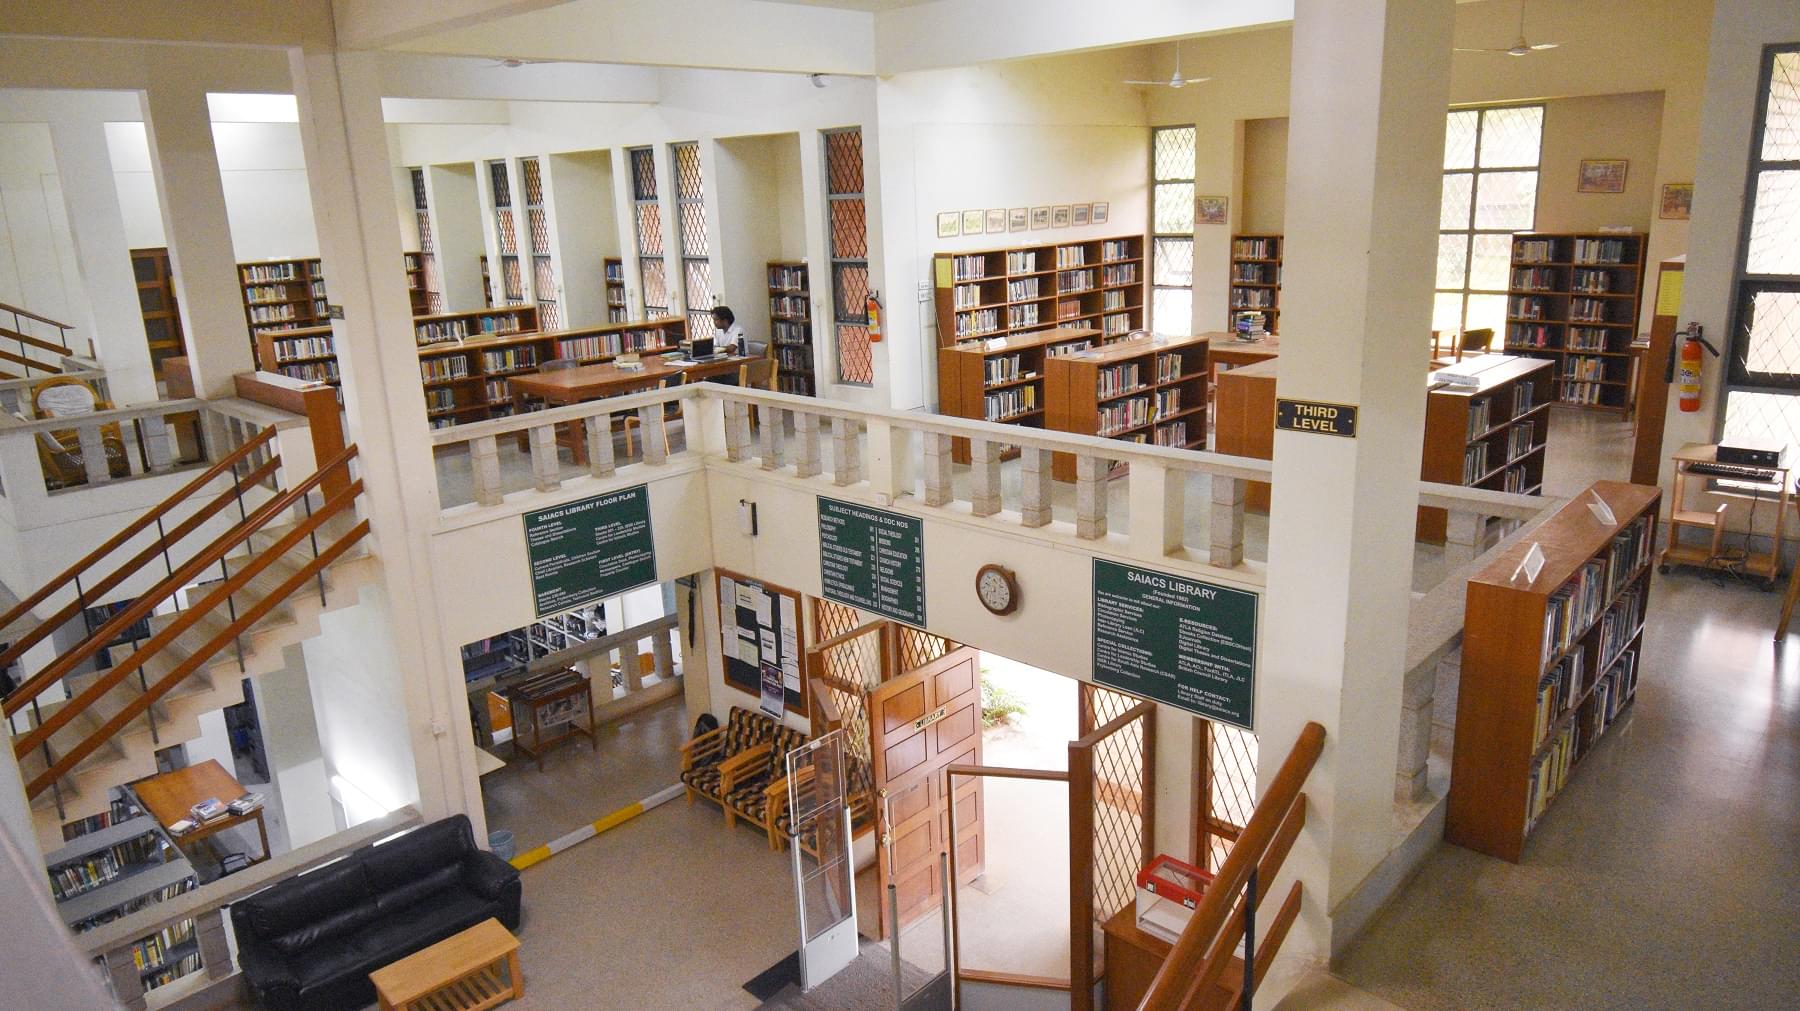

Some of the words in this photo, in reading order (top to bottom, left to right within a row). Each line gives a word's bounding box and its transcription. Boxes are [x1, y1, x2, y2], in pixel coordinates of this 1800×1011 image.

[1295, 404, 1338, 419] THIRD
[1293, 417, 1338, 432] LEVEL
[538, 510, 564, 522] SAIACS
[565, 503, 594, 515] LIBRARY
[595, 497, 618, 508] FLOOR
[619, 492, 636, 502] PLAN
[829, 505, 851, 516] SUBJECT
[851, 510, 878, 522] HEADINGS
[896, 520, 909, 529] NOS
[553, 553, 566, 561] LEVEL
[1128, 571, 1166, 589] SAIACS
[1169, 581, 1217, 601] LIBRARY
[1098, 597, 1118, 606] LIBRARY
[1142, 594, 1165, 603] GENERAL
[1166, 599, 1200, 612] INFORMATION
